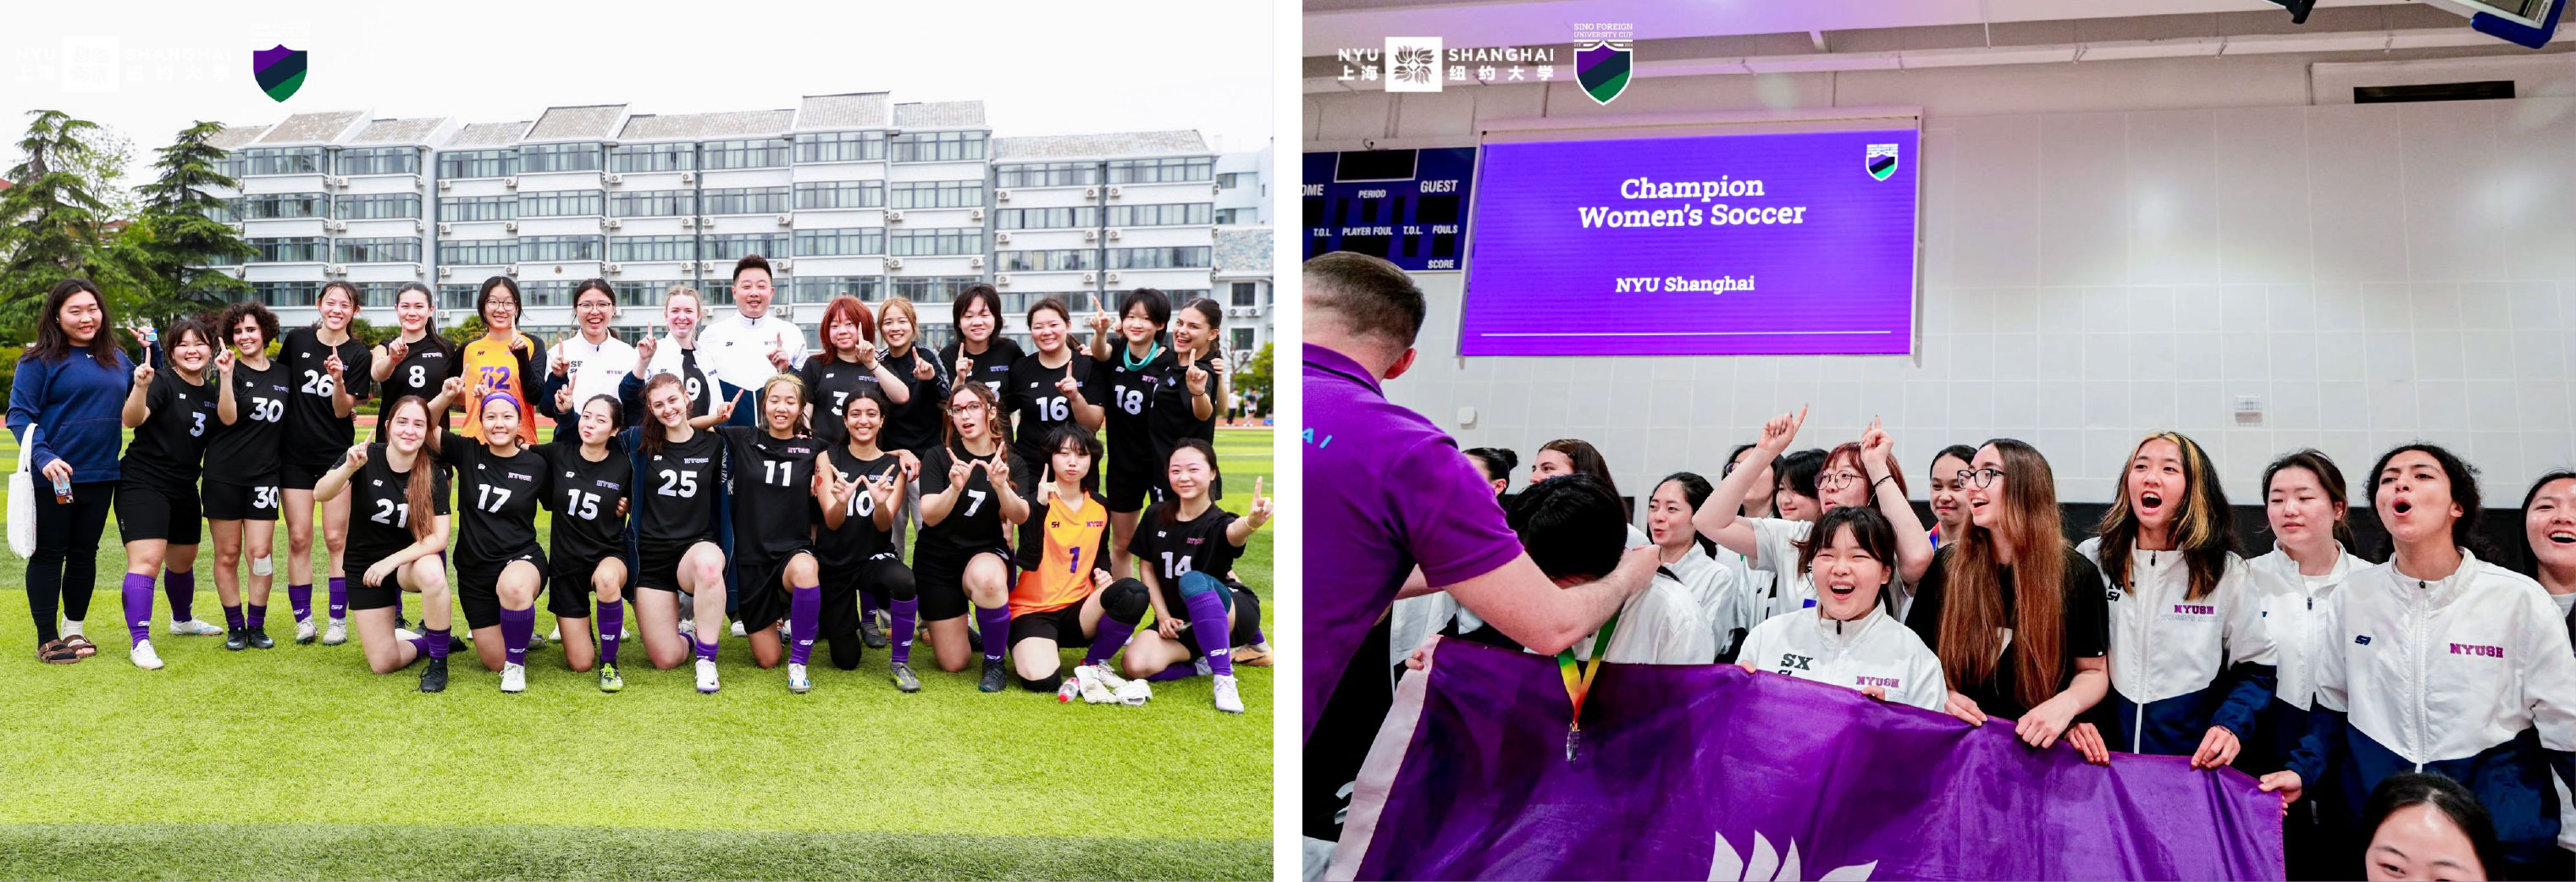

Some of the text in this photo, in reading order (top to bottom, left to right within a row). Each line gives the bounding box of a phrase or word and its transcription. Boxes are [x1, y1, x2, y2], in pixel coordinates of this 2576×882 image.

[1358, 190, 1387, 199] PERIOD
[1420, 179, 1458, 193] GUEST
[1620, 174, 1765, 202] Champion
[1578, 203, 1807, 229] Women's Soccer
[1341, 227, 1371, 236] PLAYER
[1372, 226, 1393, 236] FOUL
[1432, 224, 1458, 234] FOULS
[1428, 259, 1455, 269] SCORE
[1615, 274, 1755, 295] NYU Shanghai
[301, 369, 334, 398] 26
[408, 366, 426, 389] 8
[249, 396, 284, 423] 30
[1036, 395, 1070, 422] 16
[1114, 384, 1144, 416] 18
[189, 411, 207, 438] 3
[657, 468, 698, 499] 25
[763, 460, 793, 488] 11
[252, 486, 279, 510] 30
[477, 482, 512, 514] 17
[567, 488, 602, 521] 15
[846, 489, 875, 517] 10
[963, 488, 987, 517] 7
[370, 498, 409, 529] 21
[1069, 546, 1081, 574] 1
[1161, 551, 1192, 579] 14
[1780, 653, 1814, 671] SX
[2449, 642, 2504, 659] NYUSH
